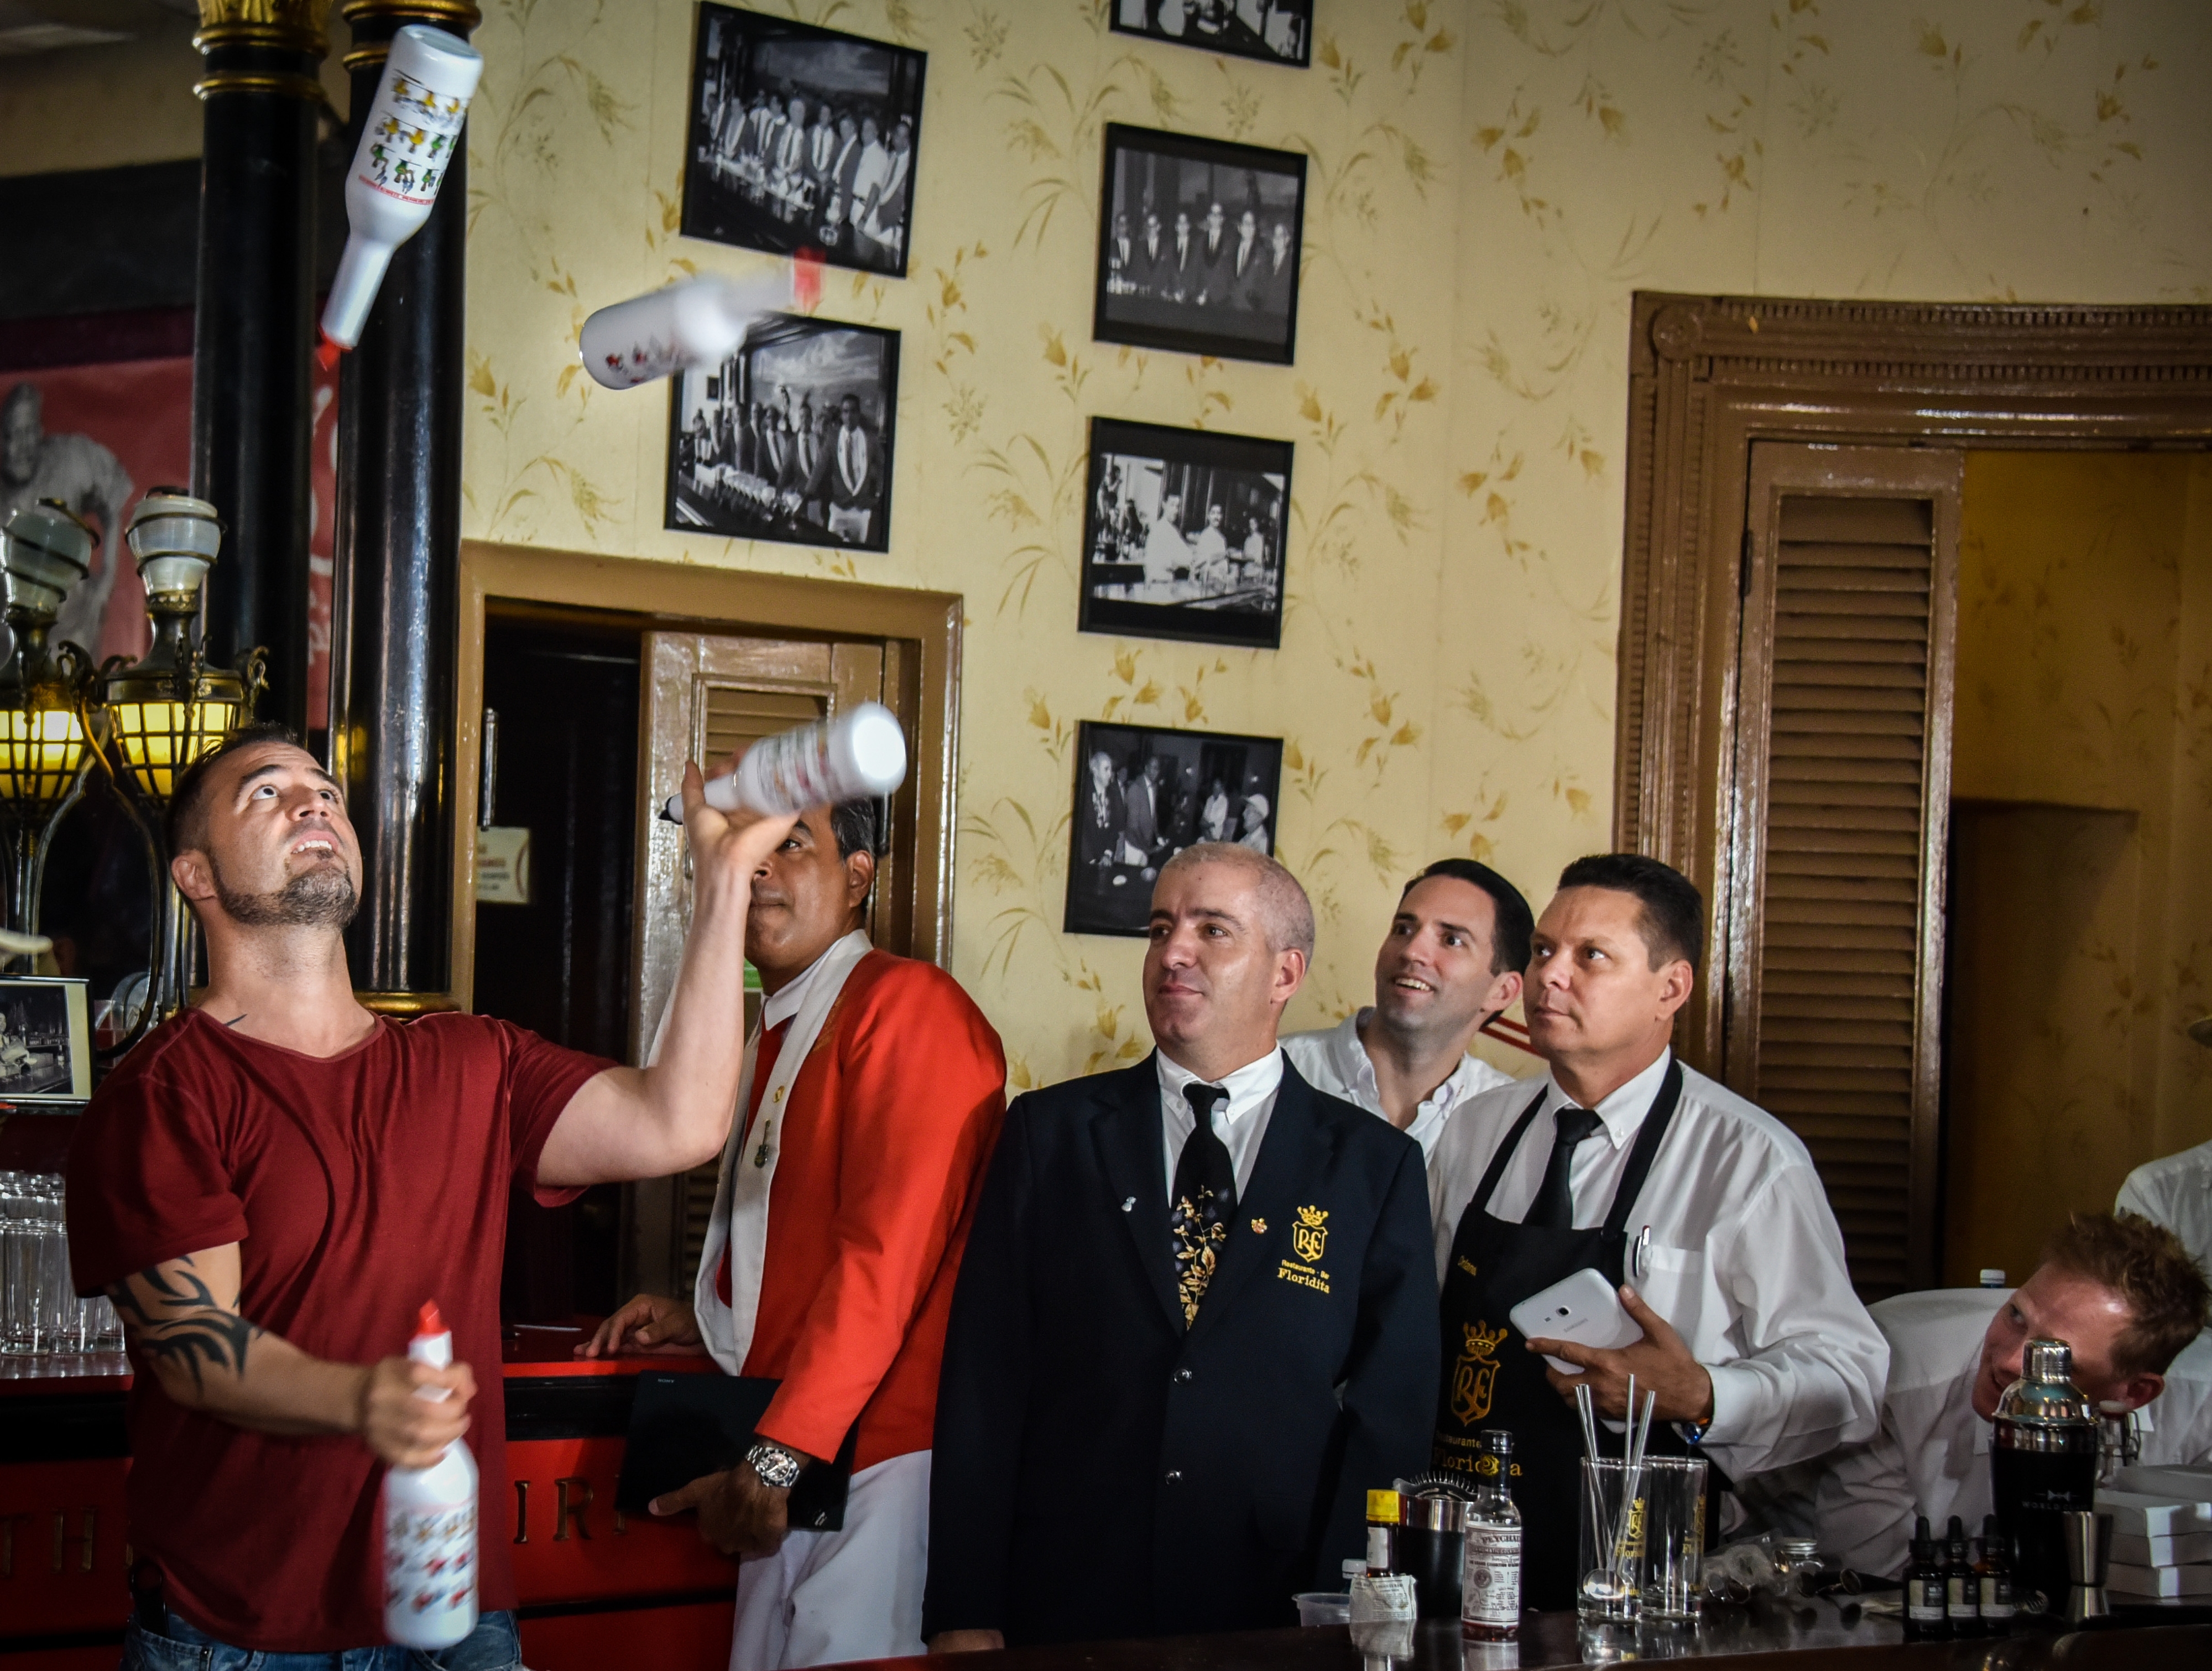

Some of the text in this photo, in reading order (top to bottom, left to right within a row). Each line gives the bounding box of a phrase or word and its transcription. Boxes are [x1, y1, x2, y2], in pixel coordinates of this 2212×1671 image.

[1277, 1267, 1330, 1294] Floridita
[1281, 1259, 1329, 1279] Restaurante Bar
[1434, 1447, 1522, 1476] Floria
[2021, 1501, 2061, 1511] WORLD
